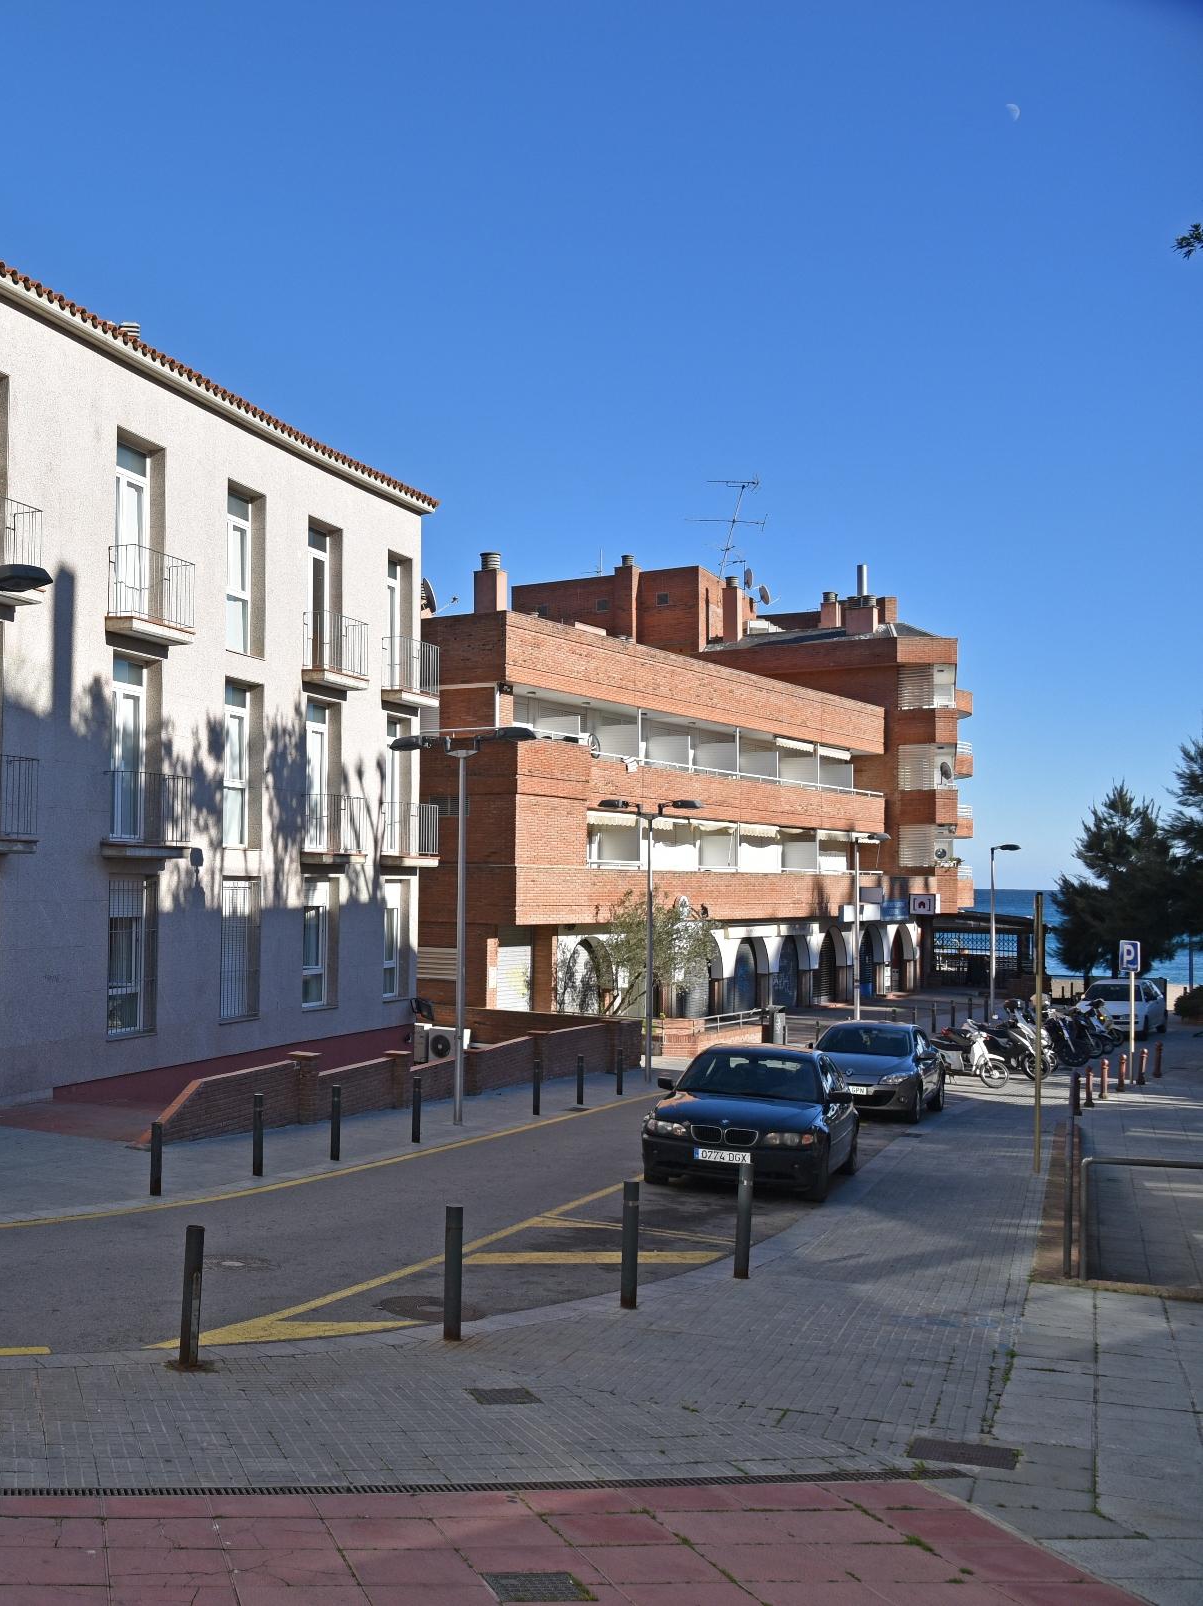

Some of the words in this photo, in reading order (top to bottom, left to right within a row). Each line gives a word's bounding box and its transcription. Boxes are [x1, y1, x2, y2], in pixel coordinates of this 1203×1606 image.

[1123, 944, 1134, 968] P
[701, 1150, 725, 1161] 0774
[728, 1152, 746, 1162] DGX
